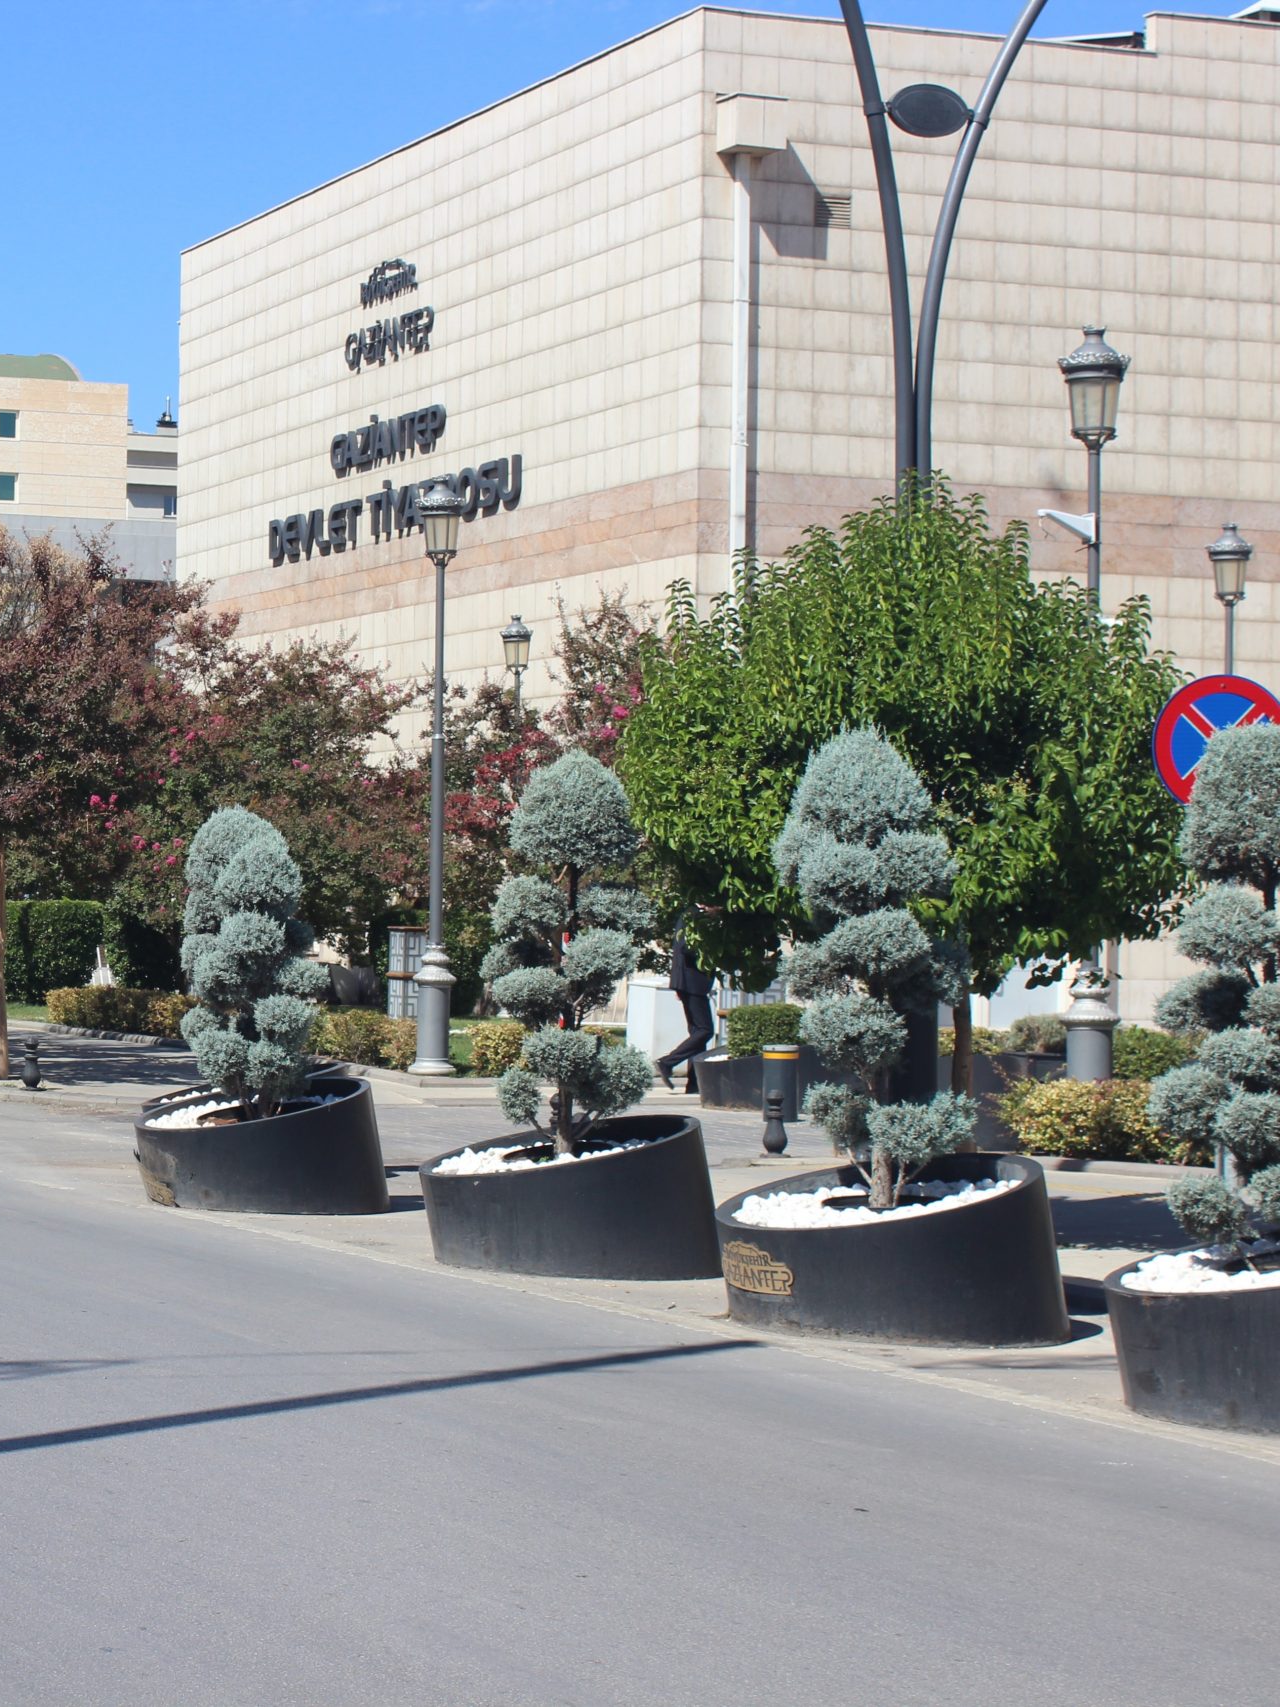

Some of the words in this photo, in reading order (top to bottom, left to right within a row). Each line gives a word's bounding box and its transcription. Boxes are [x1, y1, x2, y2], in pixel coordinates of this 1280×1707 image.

[330, 404, 446, 478] GAZİANTEP
[269, 499, 363, 567] DEVLET
[366, 454, 523, 544] TİYAOSU
